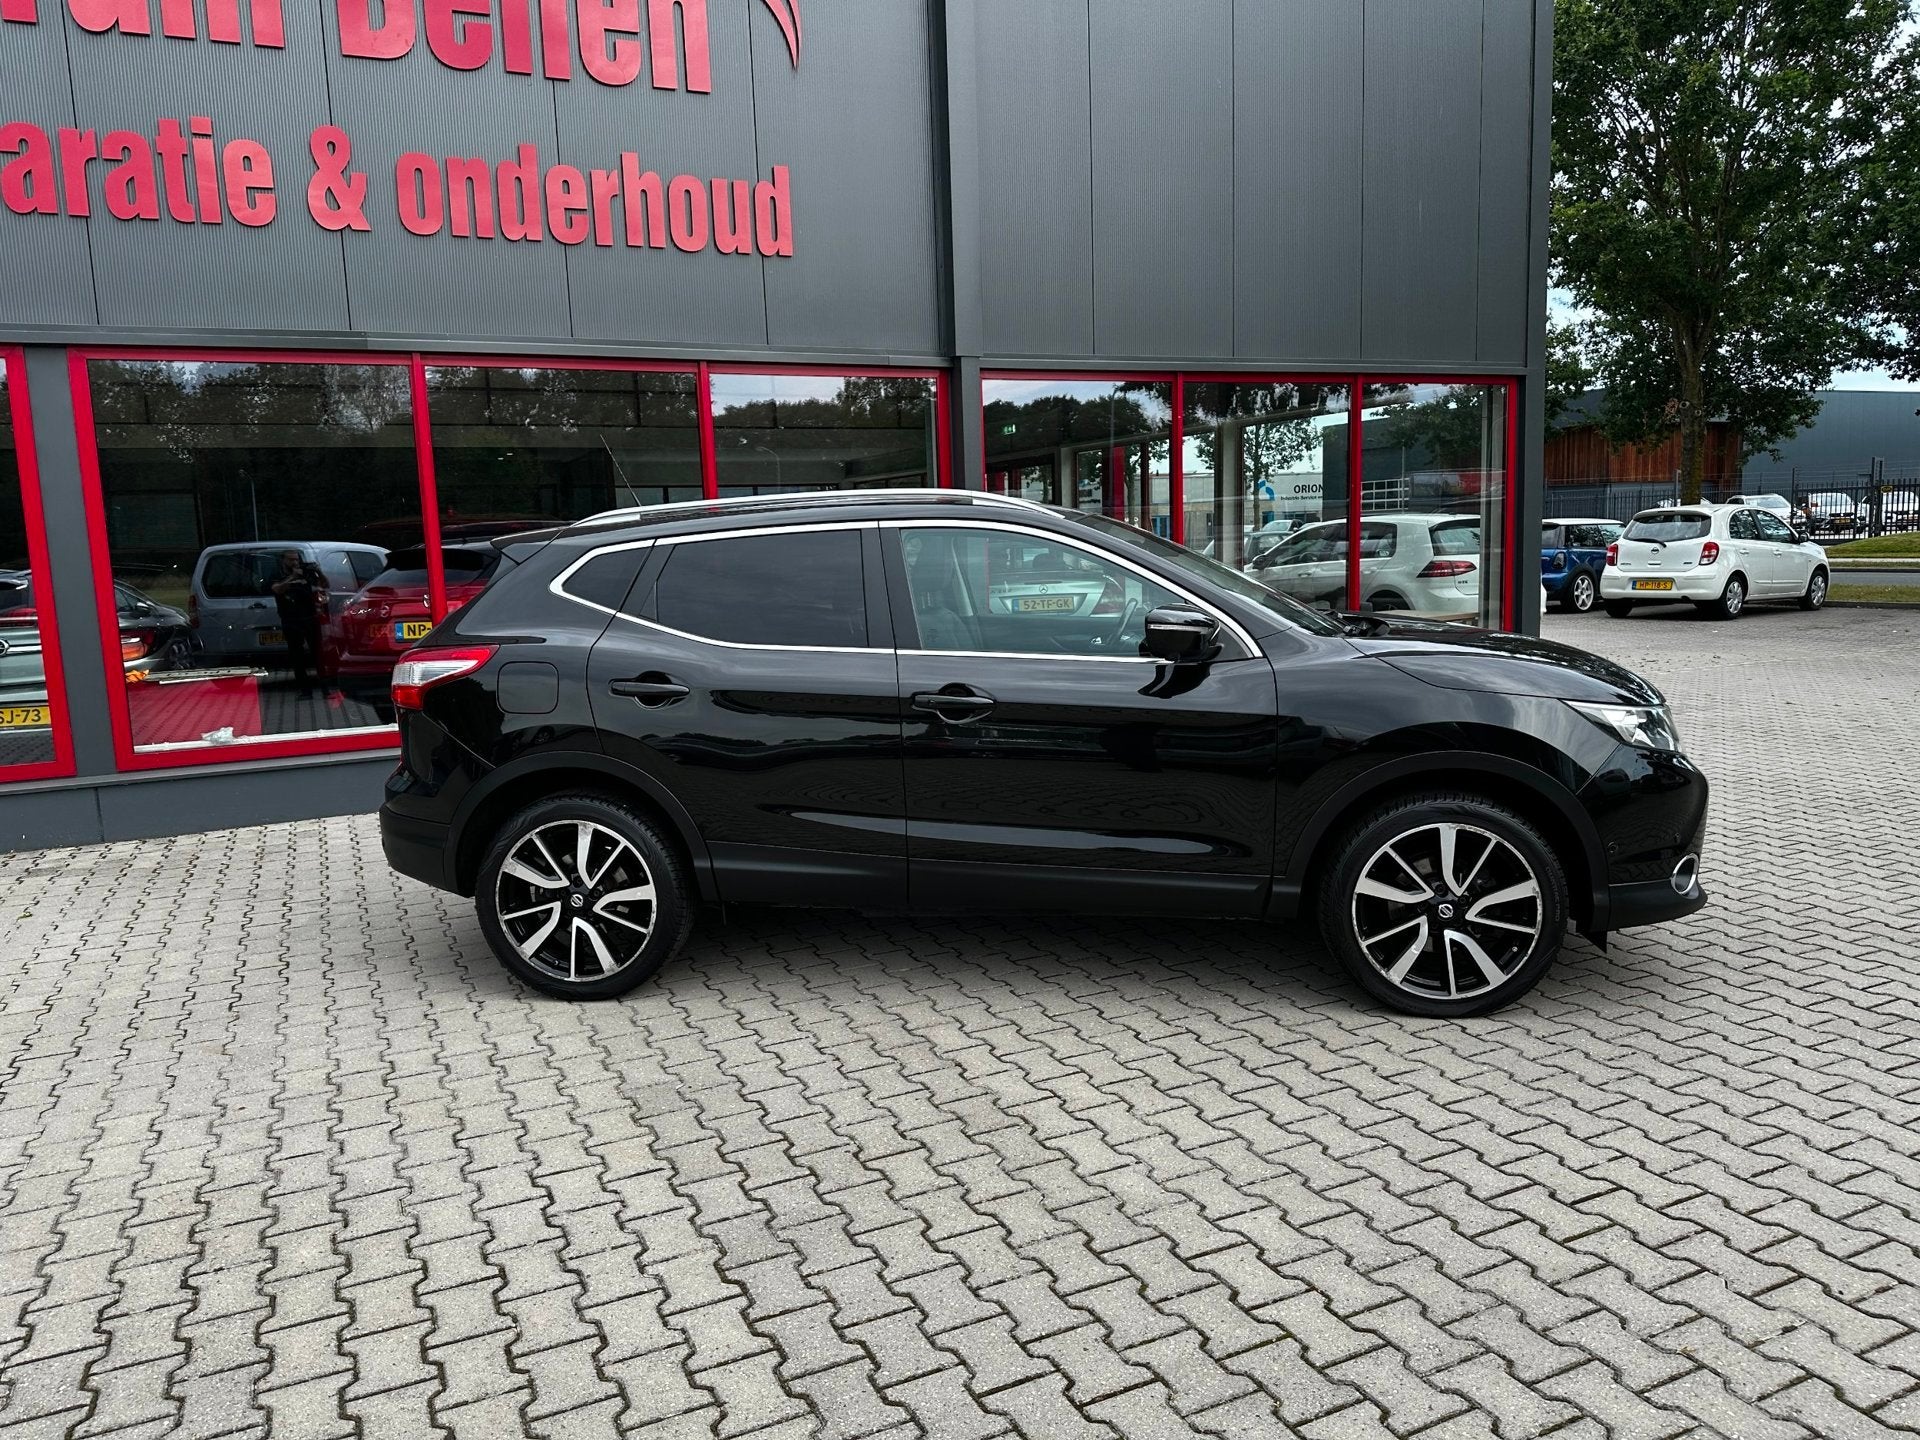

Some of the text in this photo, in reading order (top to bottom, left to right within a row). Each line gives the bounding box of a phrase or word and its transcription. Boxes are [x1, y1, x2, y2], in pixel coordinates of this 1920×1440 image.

[0, 116, 793, 257] aratie & onderhoud
[1023, 599, 1070, 610] 52-TF-GK
